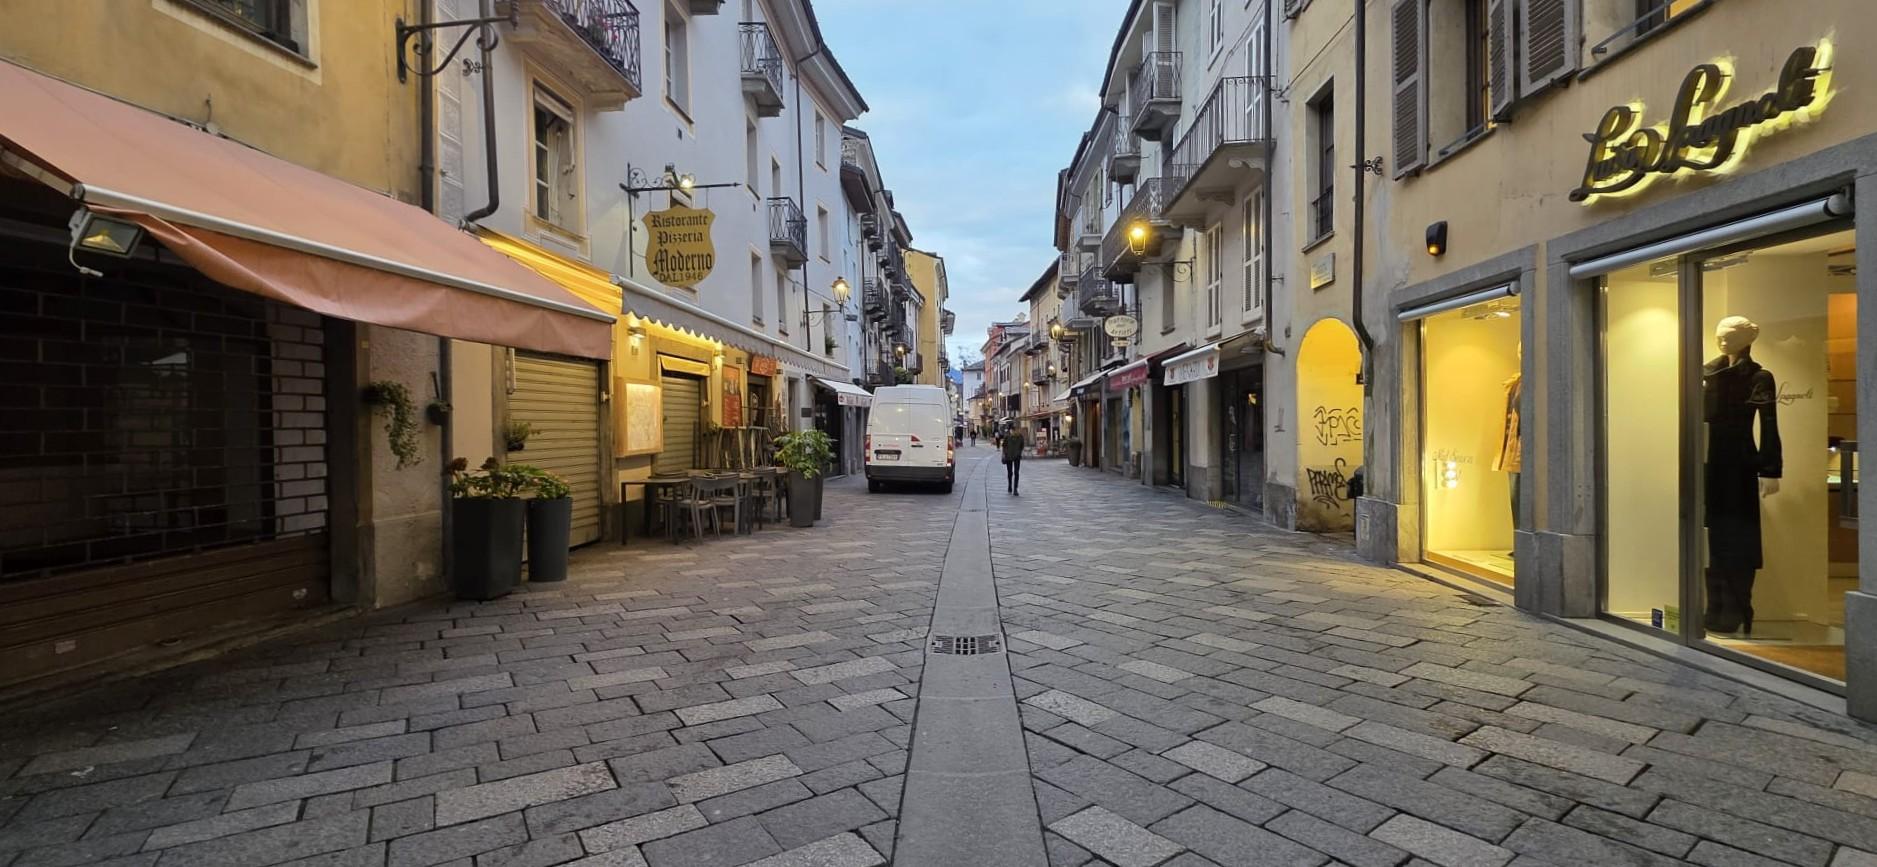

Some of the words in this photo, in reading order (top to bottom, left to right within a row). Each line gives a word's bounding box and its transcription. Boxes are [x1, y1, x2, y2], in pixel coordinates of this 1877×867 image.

[652, 214, 708, 228] Ristorante
[657, 231, 704, 247] Pizzeria
[653, 249, 713, 275] Moderno
